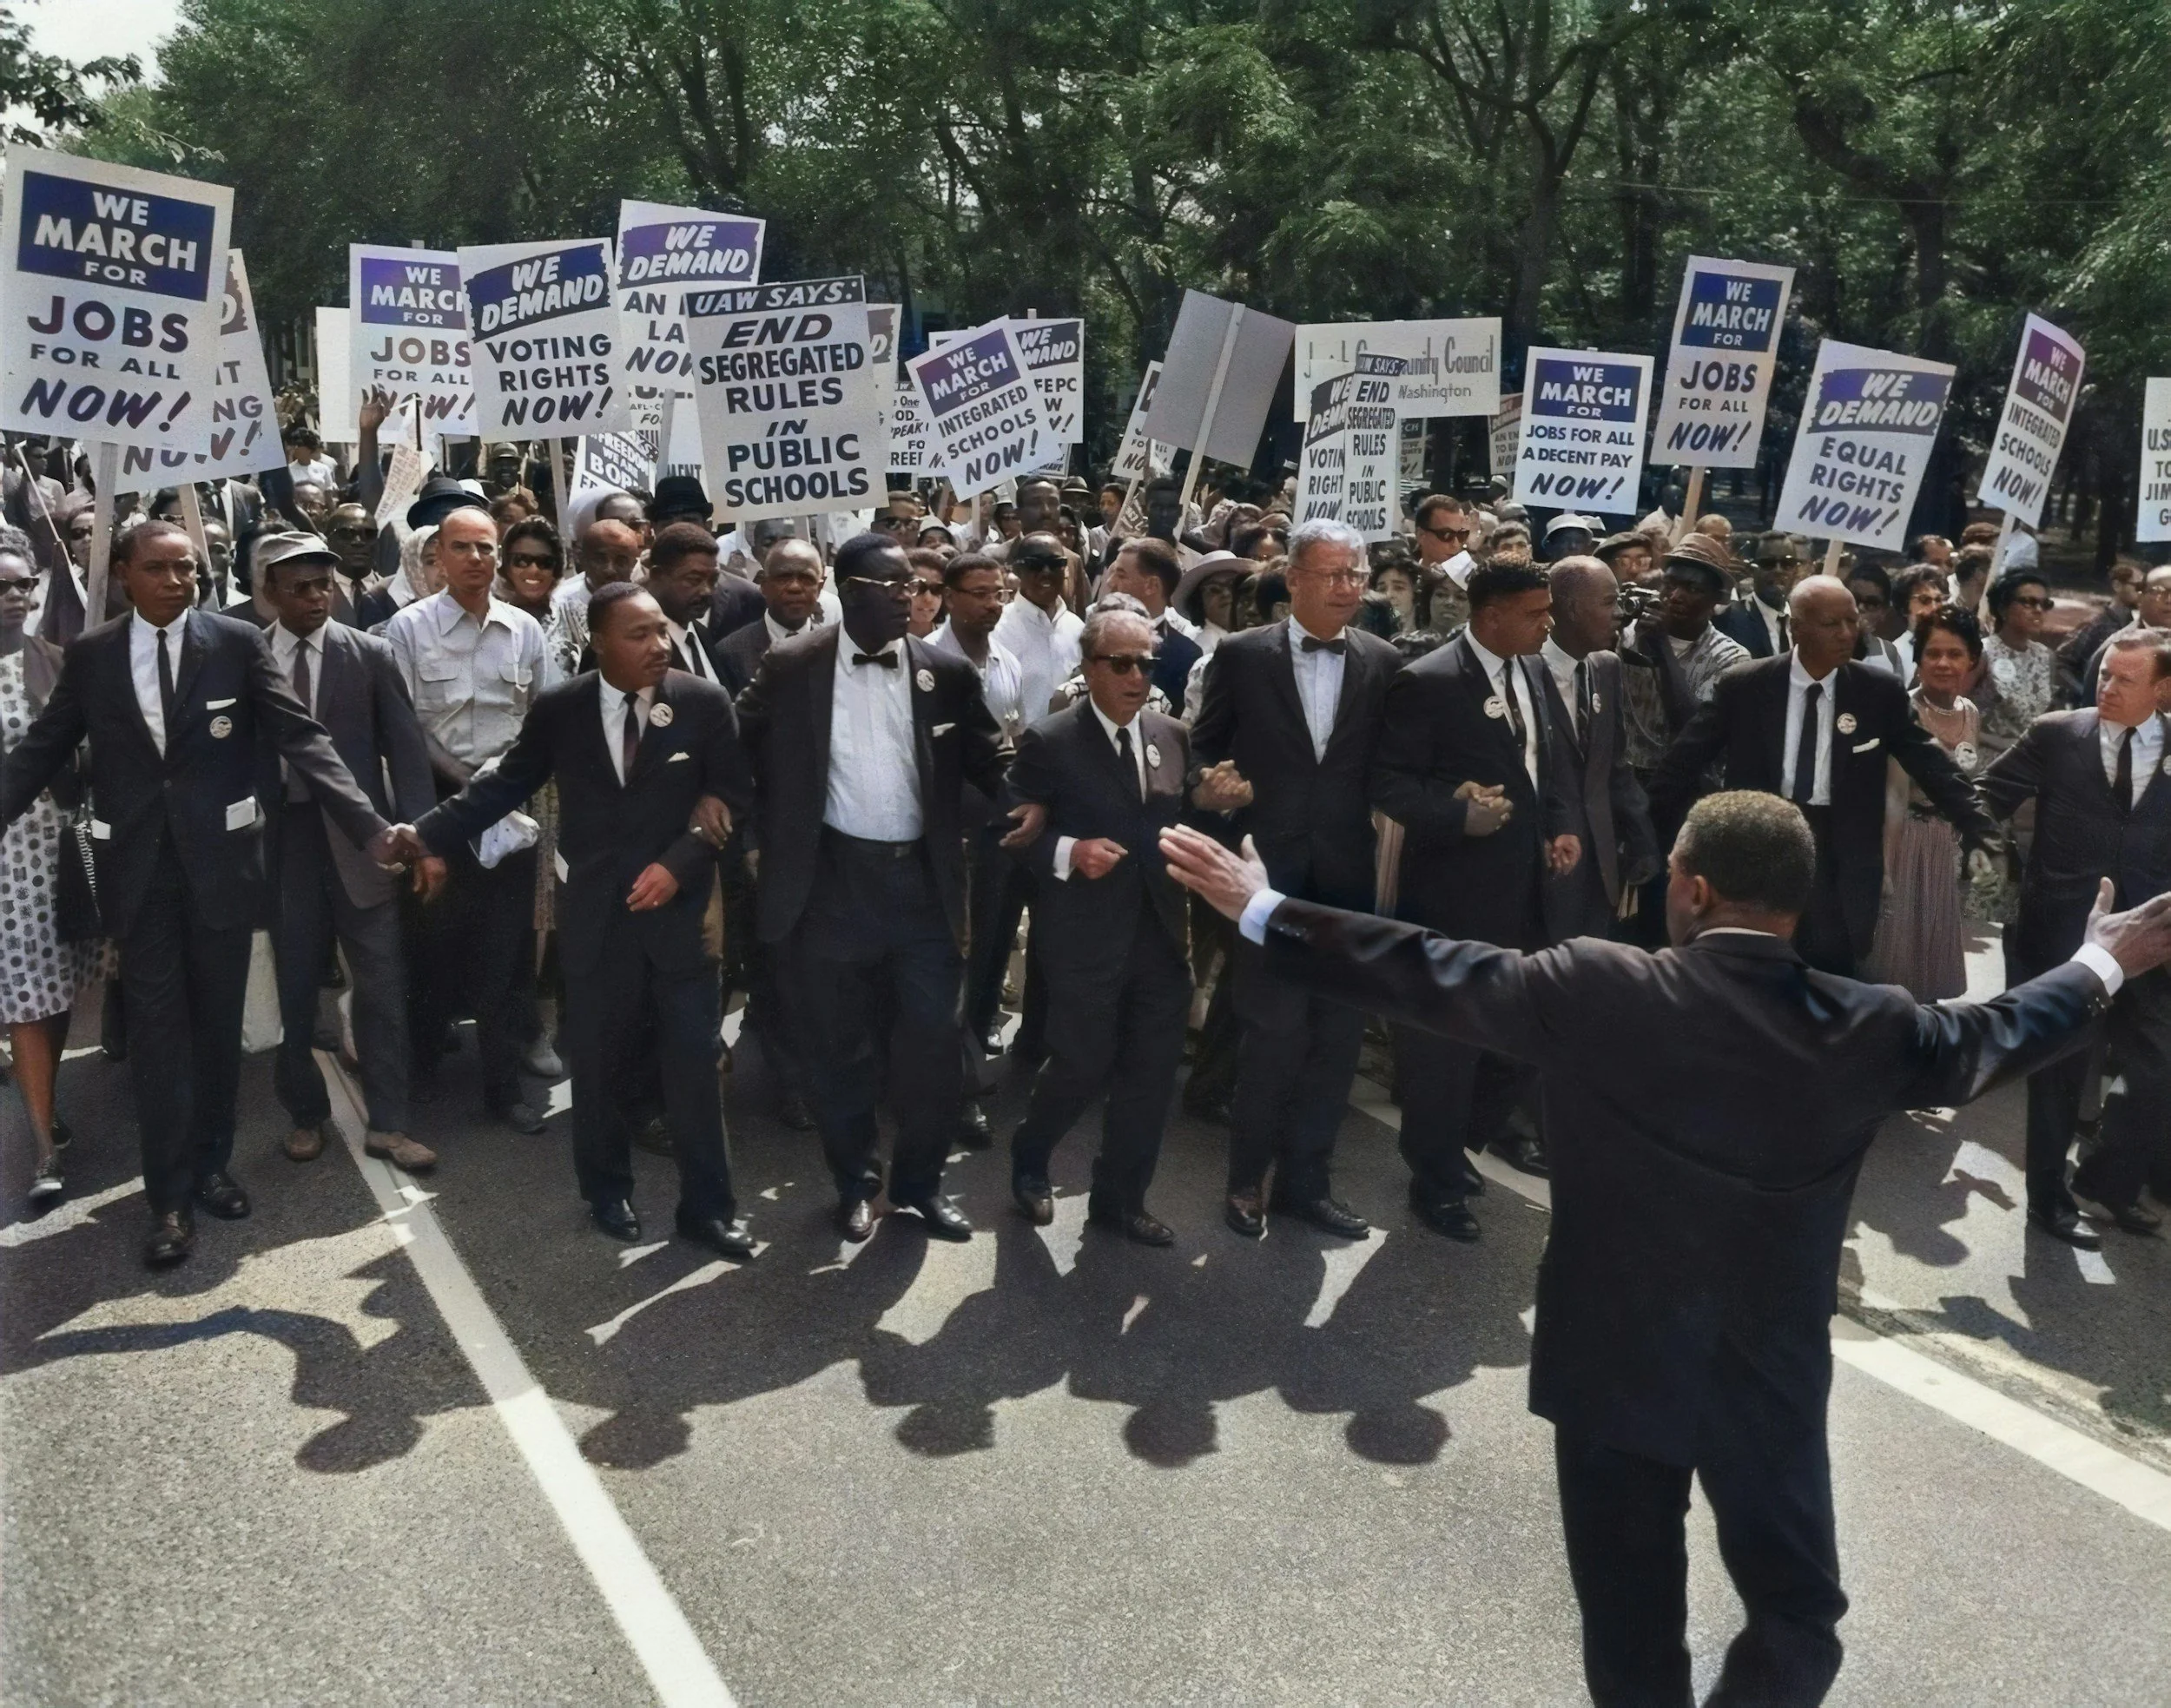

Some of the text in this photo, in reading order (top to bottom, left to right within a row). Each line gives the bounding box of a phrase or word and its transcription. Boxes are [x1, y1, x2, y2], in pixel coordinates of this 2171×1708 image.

[93, 191, 148, 226] WE
[34, 214, 197, 272] MARCH
[665, 225, 716, 250] WE
[84, 260, 147, 286] FOR
[406, 266, 441, 285] WE
[512, 256, 560, 292] WE
[628, 248, 749, 280] DEMAND
[481, 274, 604, 332] DEMAND
[624, 291, 666, 315] AN
[695, 290, 760, 313] UAW
[766, 280, 857, 307] SAYS:
[1726, 280, 1752, 302] WE
[27, 295, 188, 353] JOBS
[403, 312, 443, 325] FOR
[722, 313, 832, 348] END
[1692, 302, 1772, 333] MARCH
[649, 320, 684, 344] LA
[1021, 327, 1052, 349] WE
[1713, 333, 1743, 346] FOR
[30, 344, 180, 379] FOR ALL
[370, 337, 471, 367] JOBS
[485, 333, 611, 364] VOTING
[947, 347, 977, 369] WE
[1444, 334, 1494, 373] Council
[2050, 346, 2067, 372] WE
[373, 369, 469, 385] FOR ALL
[699, 342, 864, 385] SEGREGATED
[931, 352, 1008, 400] MARCH
[1573, 366, 1604, 383] WE
[1680, 360, 1758, 392] JOBS
[498, 364, 610, 392] RIGHTS
[960, 381, 990, 400] FOR
[1356, 381, 1389, 402] END
[1861, 373, 1913, 399] WE
[2024, 358, 2071, 405] MARCH
[19, 378, 191, 432] NOW!
[502, 386, 613, 426] NOW!
[726, 377, 843, 413] RULES
[1398, 384, 1471, 404] Washington
[1540, 382, 1632, 406] MARCH
[1679, 398, 1748, 412] FOR ALL
[2036, 392, 2055, 411] FOR
[938, 386, 1027, 438] INTEGRATED
[1348, 406, 1395, 430] SEGREGATED
[1567, 406, 1601, 417] FOR
[1818, 399, 1937, 426] DEMAND
[2008, 402, 2061, 449] INTEGRATED
[766, 419, 808, 438] IN
[947, 409, 1036, 459] SCHOOLS
[1527, 425, 1634, 445] JOBS FOR ALL
[1667, 421, 1752, 452] NOW!
[728, 433, 860, 472] PUBLIC
[967, 429, 1038, 485] NOW!
[1310, 449, 1345, 469] VOTIN
[1353, 434, 1386, 456] RULES
[1521, 446, 1535, 460] A
[1538, 448, 1597, 465] DECENT
[1600, 452, 1633, 468] PAY
[1819, 436, 1906, 476] EQUAL
[1999, 432, 2051, 477] SCHOOLS
[1308, 475, 1343, 495] RIGHT
[1362, 465, 1375, 478] IN
[1809, 463, 1904, 504] RIGHTS
[725, 467, 869, 507] SCHOOLS
[1349, 480, 1386, 504] PUBLIC
[1529, 472, 1625, 500] NOW!
[1992, 466, 2042, 509] NOW!
[1347, 507, 1386, 531] SCHOOLS
[1798, 495, 1899, 536] NOW!
